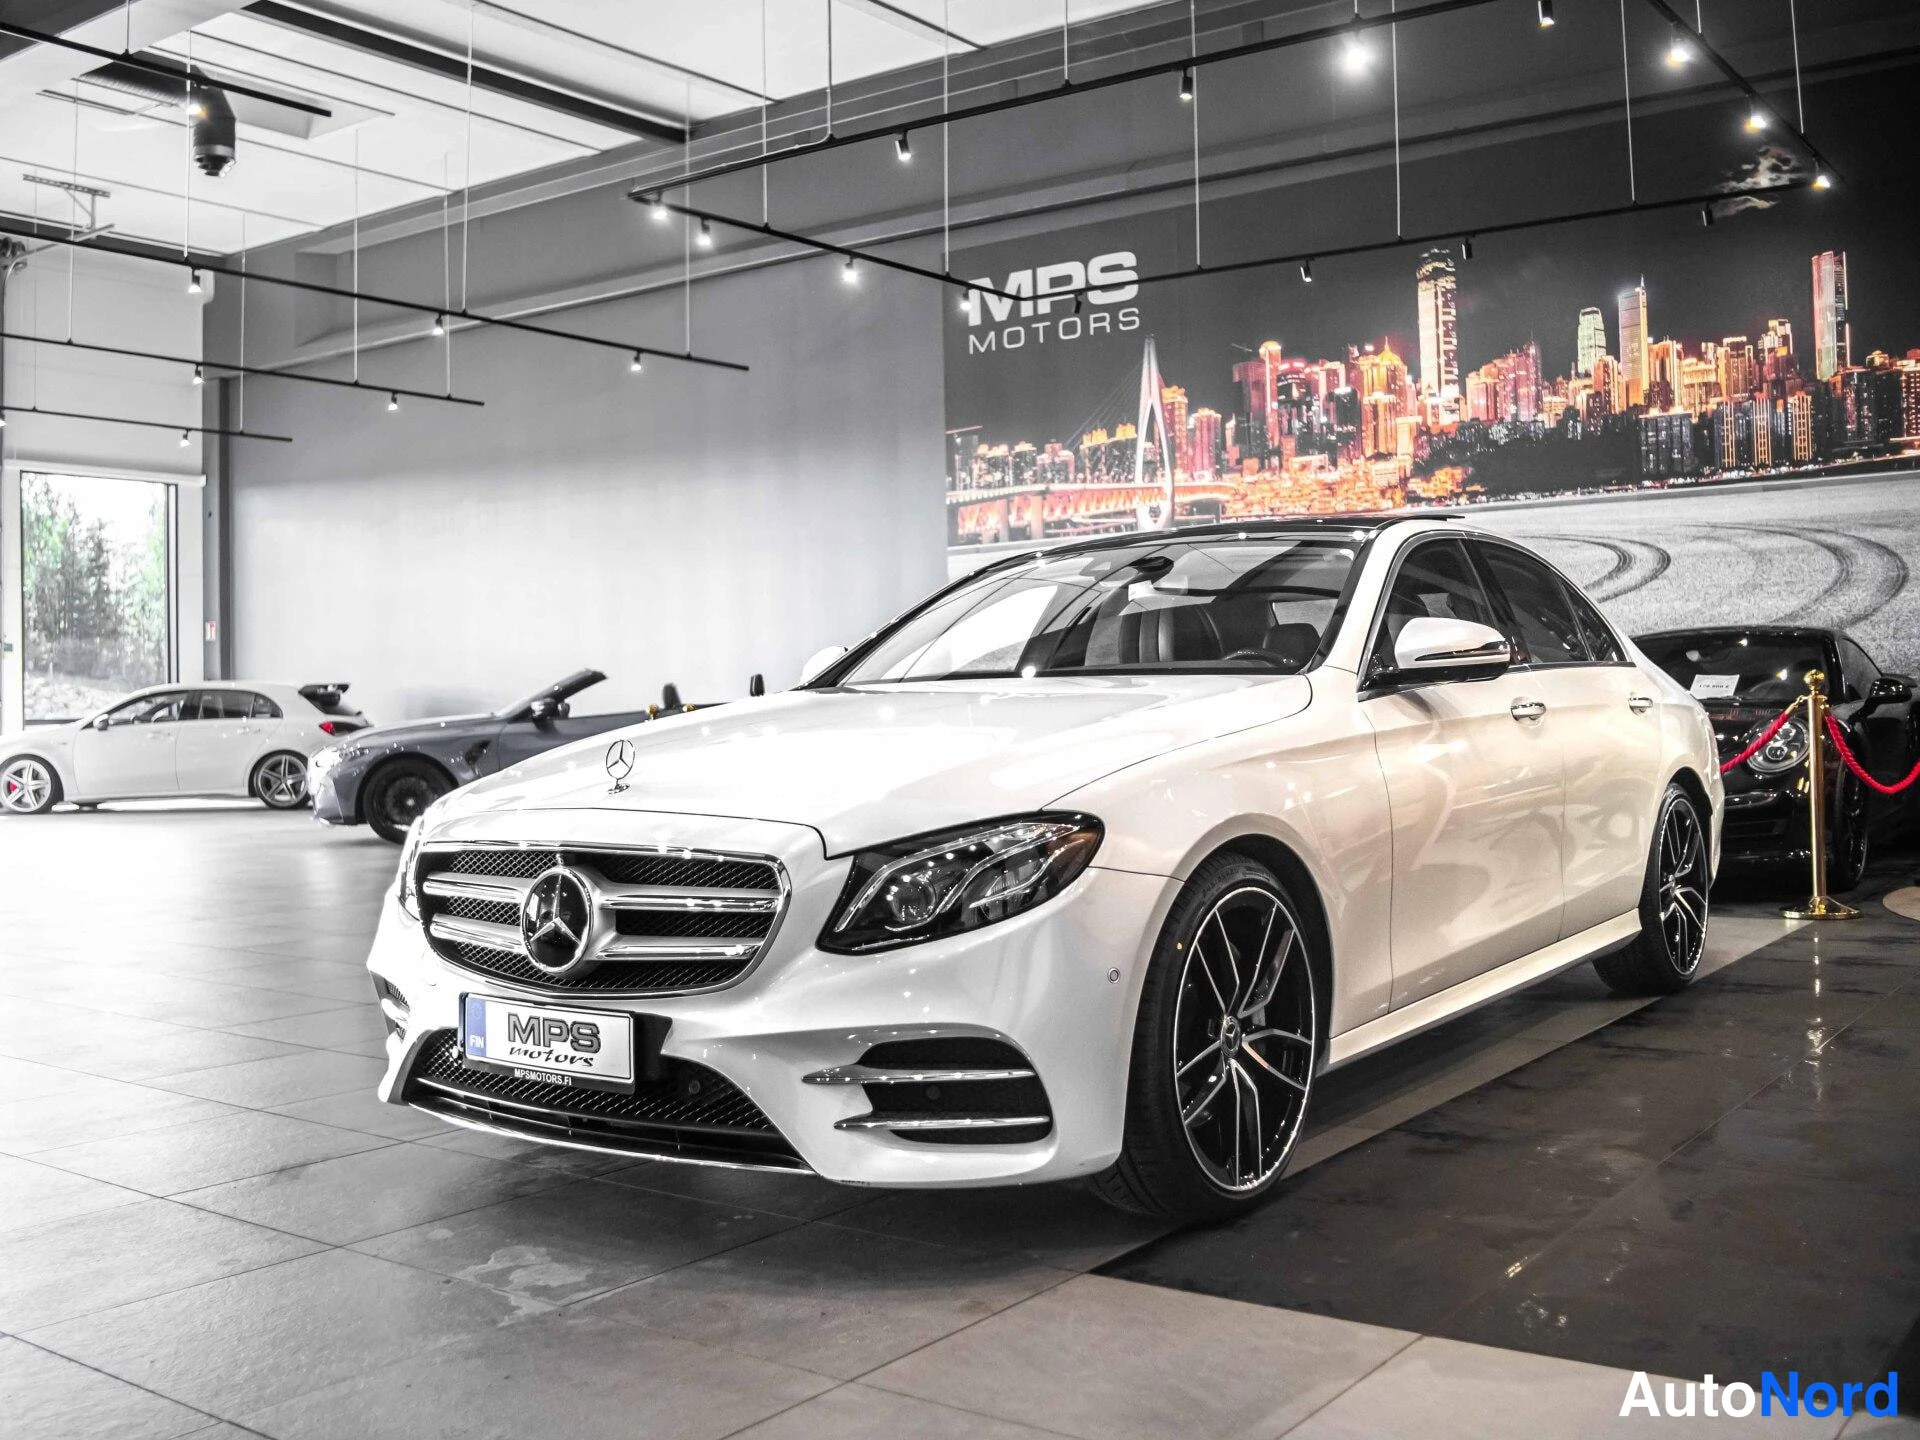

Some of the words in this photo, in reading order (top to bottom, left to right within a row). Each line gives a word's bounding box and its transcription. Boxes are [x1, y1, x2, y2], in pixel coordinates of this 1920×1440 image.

[968, 251, 1139, 327] MPS
[969, 307, 1140, 355] MOTORS
[469, 1035, 485, 1049] FIN
[507, 1012, 602, 1054] MPS
[509, 1046, 594, 1067] motors
[514, 1068, 572, 1086] MPSMOTORS.FI
